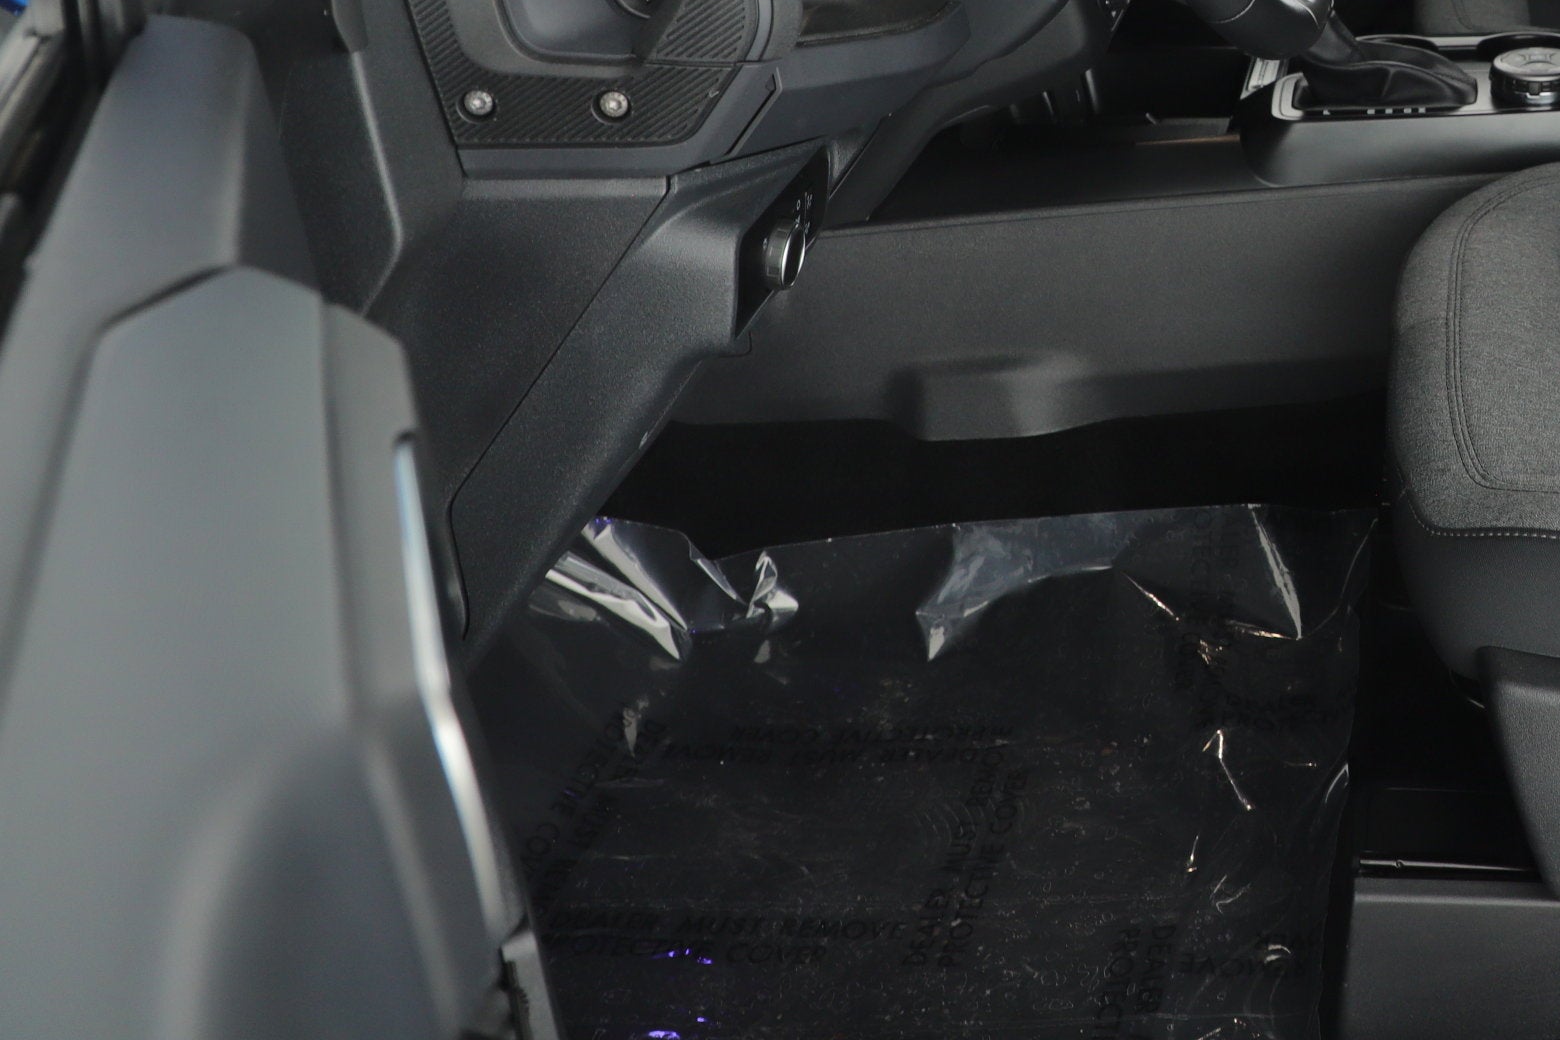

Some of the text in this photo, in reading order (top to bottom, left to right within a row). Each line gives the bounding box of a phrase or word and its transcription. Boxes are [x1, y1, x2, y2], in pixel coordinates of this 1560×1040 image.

[729, 725, 819, 744] COVER
[900, 888, 953, 967] DEALER
[941, 820, 979, 874] MUST
[937, 767, 1031, 969] PROTECTIVE COVER
[677, 915, 767, 935] MUST
[779, 917, 903, 940] REMOVE
[725, 943, 829, 965] COVER
[1134, 924, 1178, 1016] DEALER
